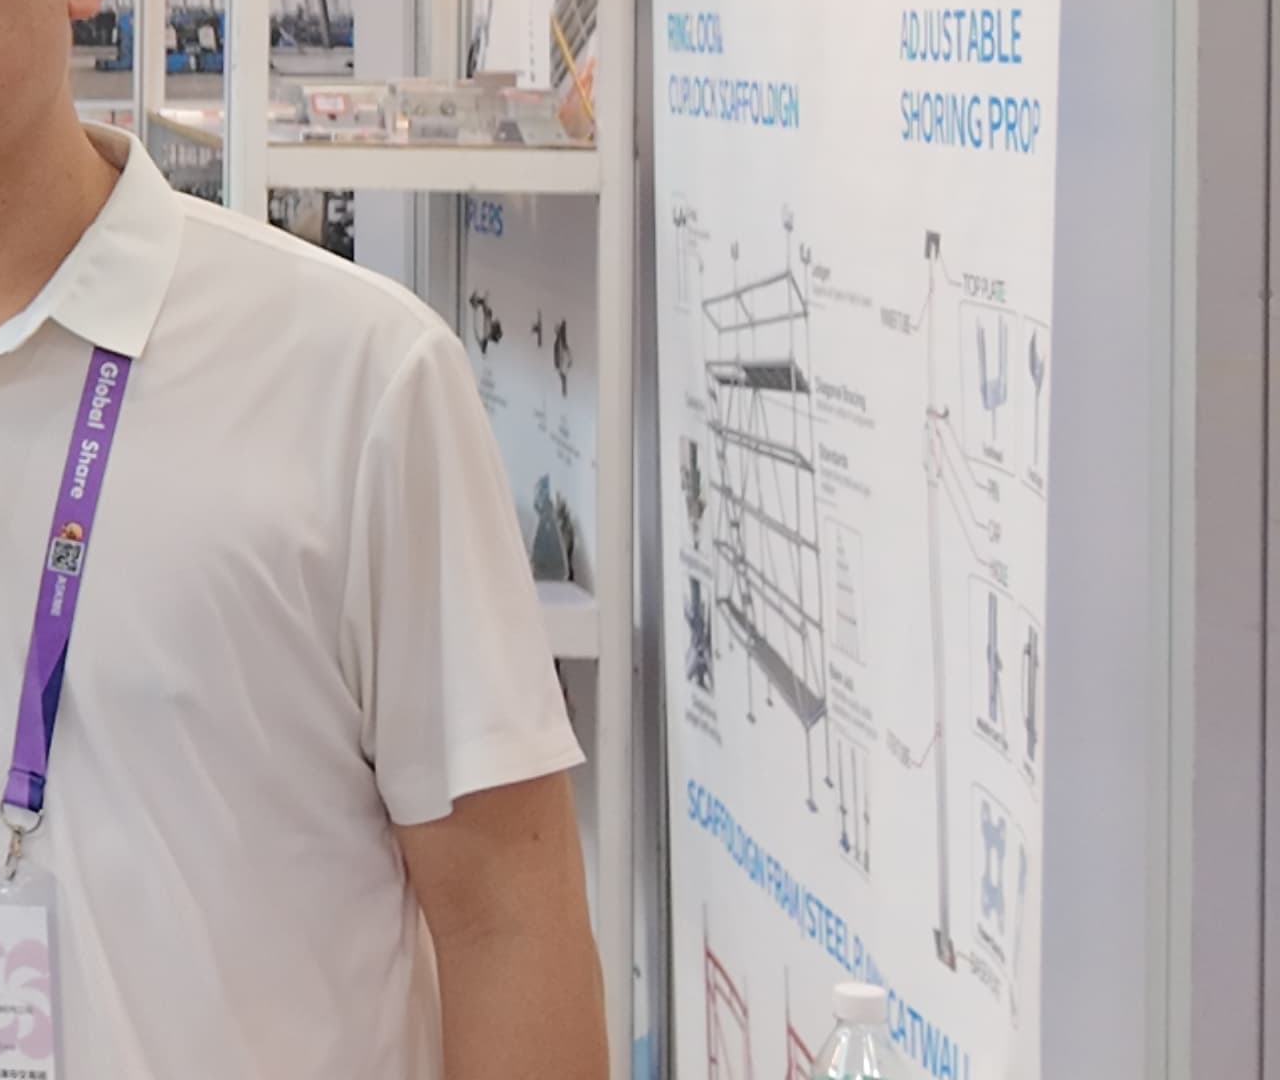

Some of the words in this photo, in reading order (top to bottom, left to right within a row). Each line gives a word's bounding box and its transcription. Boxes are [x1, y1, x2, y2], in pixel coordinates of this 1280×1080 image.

[899, 8, 1022, 64] ADJUSTABLE
[900, 90, 983, 149] SHORING
[87, 361, 119, 430] Global
[70, 439, 100, 500] Share
